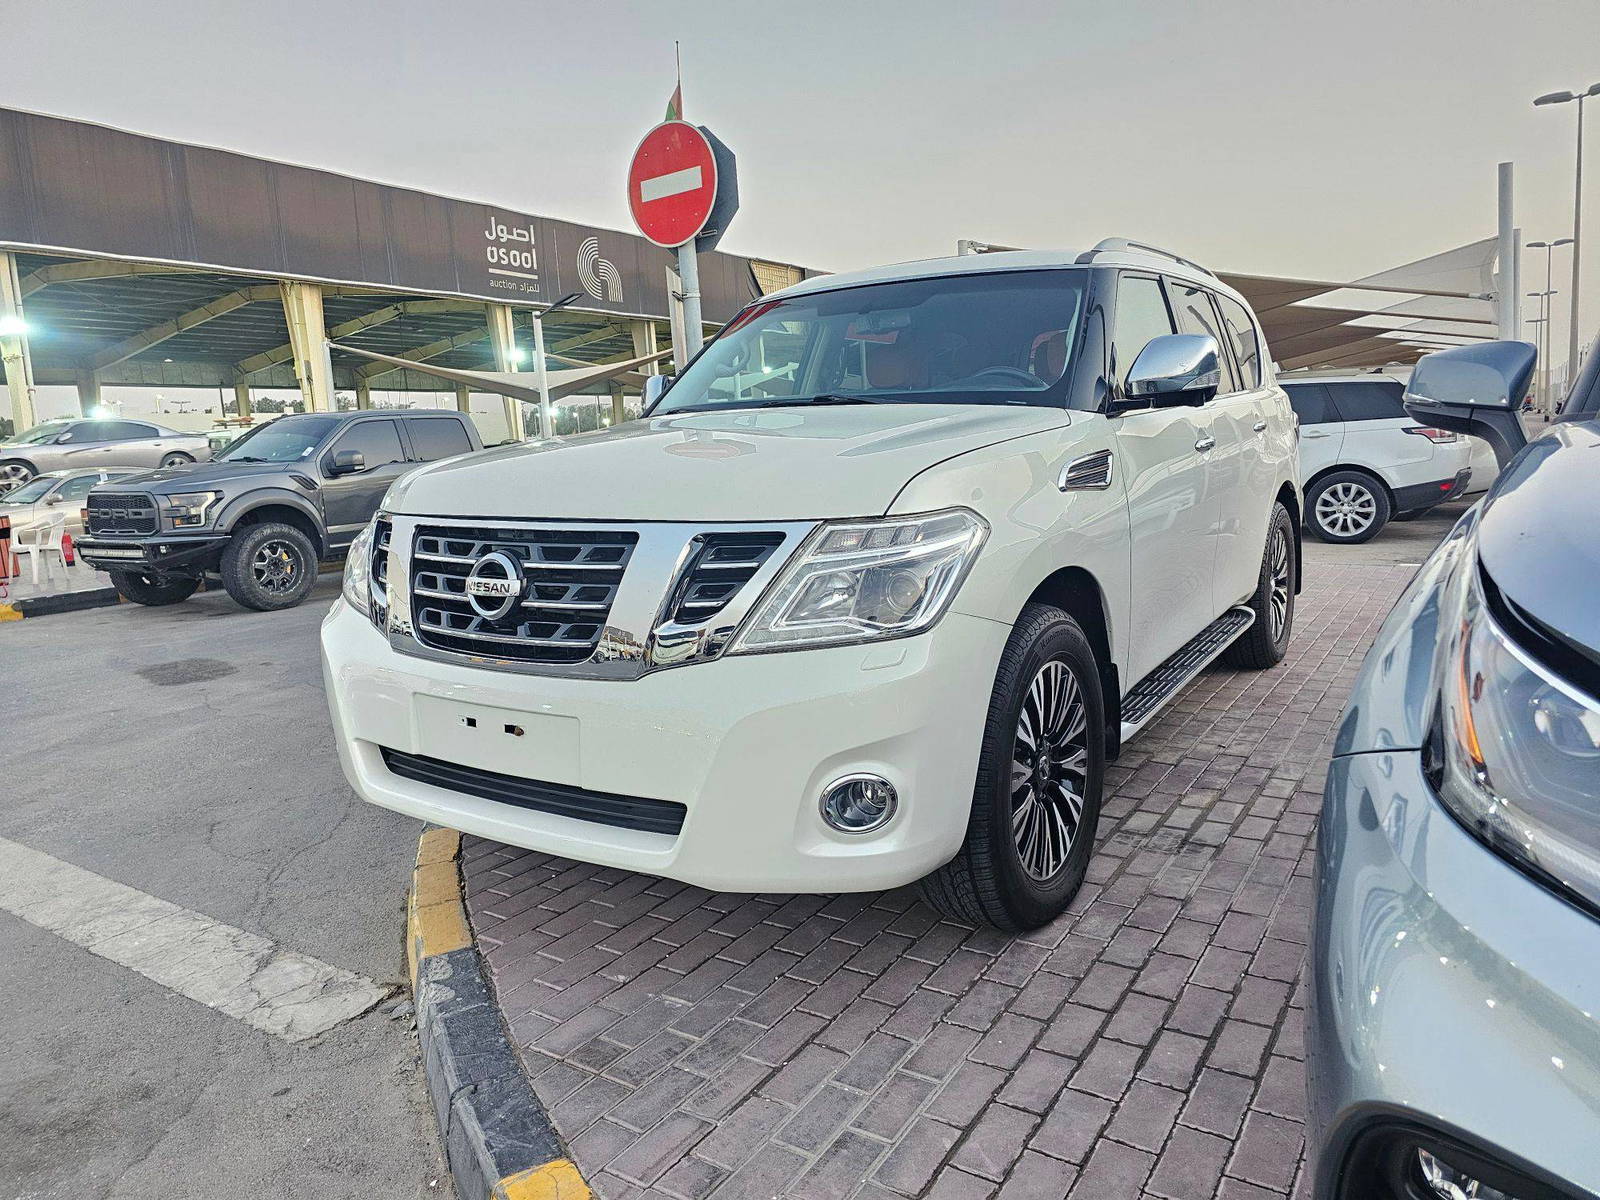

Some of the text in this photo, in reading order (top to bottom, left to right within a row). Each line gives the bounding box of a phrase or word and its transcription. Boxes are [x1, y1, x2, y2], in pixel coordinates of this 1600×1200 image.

[484, 216, 535, 245] اصول
[486, 246, 537, 270] osool
[489, 279, 517, 290] auction
[519, 282, 540, 293] للمزاد
[88, 508, 146, 519] FORD
[467, 581, 510, 593] NISSAN
